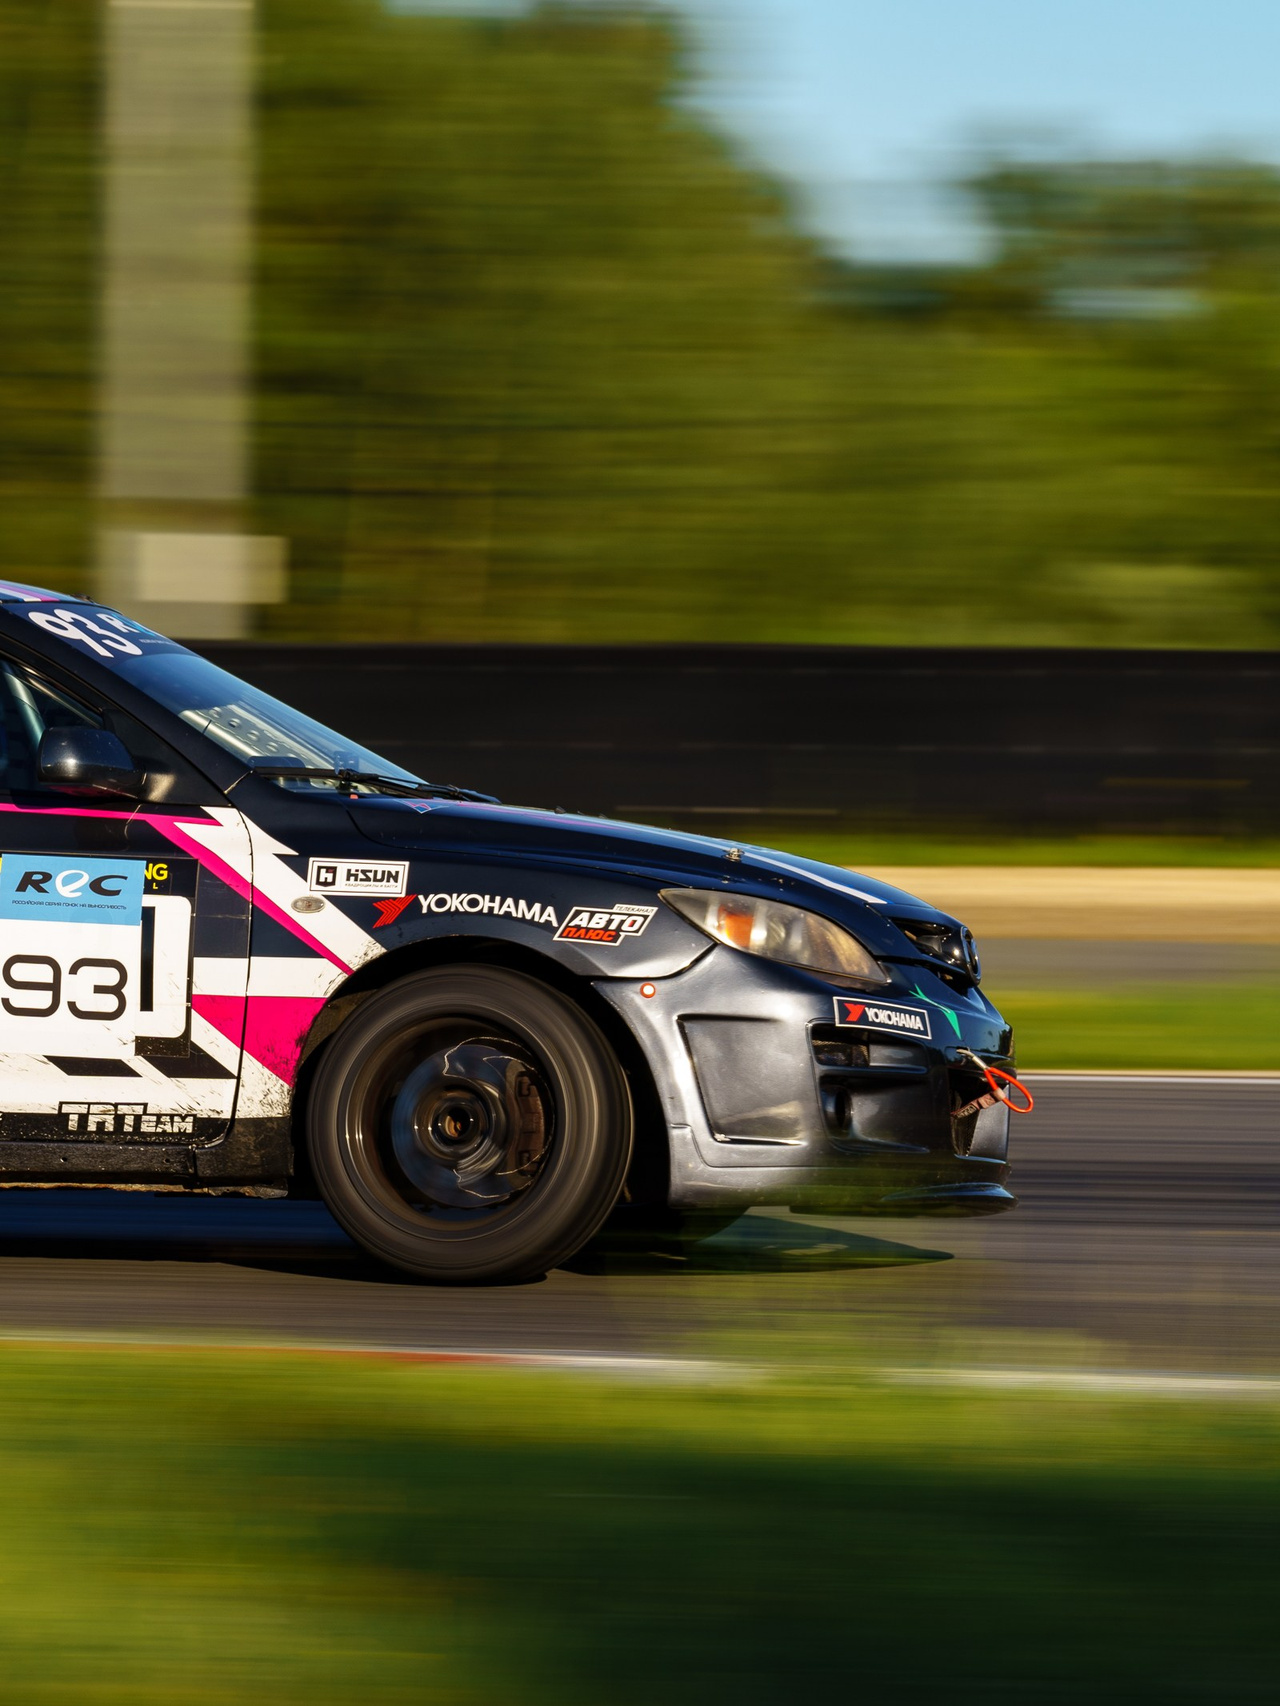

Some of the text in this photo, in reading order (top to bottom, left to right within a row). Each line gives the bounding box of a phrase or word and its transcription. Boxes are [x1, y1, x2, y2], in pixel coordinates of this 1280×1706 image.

[28, 608, 143, 658] 93
[418, 893, 558, 927] YOKOHAMA
[569, 912, 645, 932] АВТО
[561, 927, 616, 941] ПЛЮС
[1, 954, 128, 1021] 93
[865, 1007, 924, 1031] YOKOHAMA
